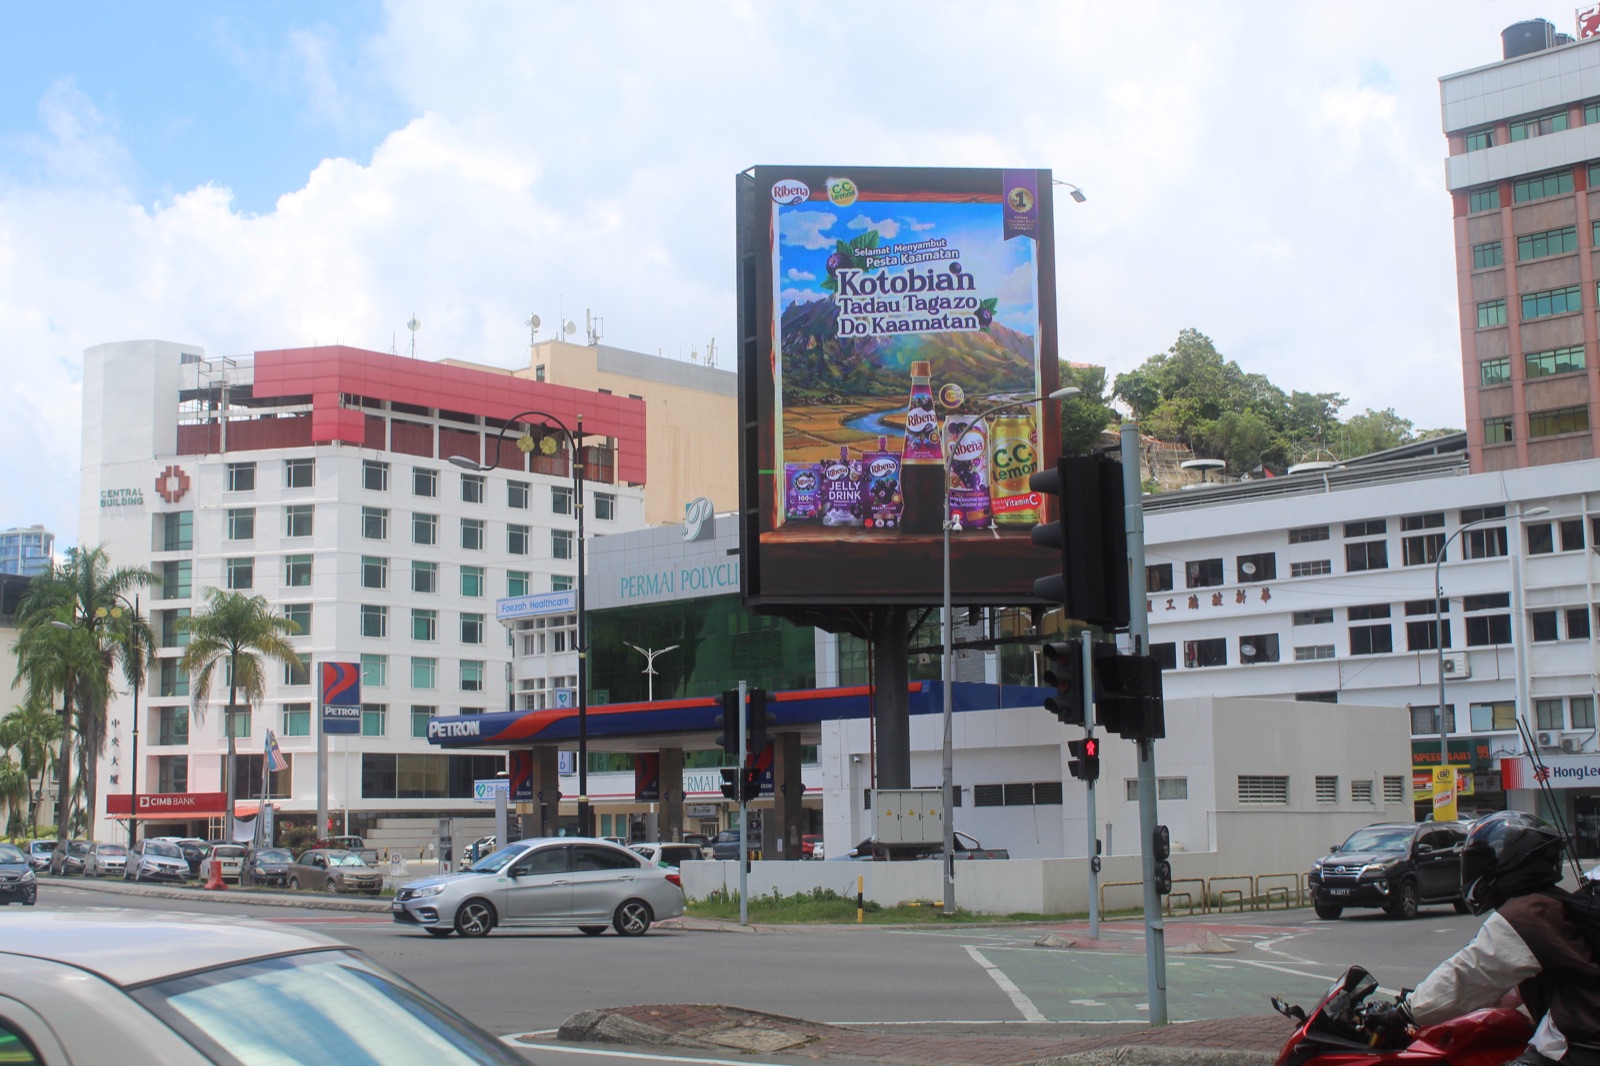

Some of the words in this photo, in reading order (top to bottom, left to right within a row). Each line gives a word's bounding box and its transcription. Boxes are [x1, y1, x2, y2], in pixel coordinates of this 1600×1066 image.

[774, 185, 808, 198] Ribena
[854, 247, 890, 257] Selamat
[894, 237, 947, 253] Menyambut
[866, 255, 898, 268] Pesta
[901, 249, 959, 265] Kaamatan
[839, 268, 976, 296] Kotobian
[839, 296, 901, 315] Tadau
[903, 293, 978, 316] Tagazo
[840, 318, 867, 336] Do
[872, 313, 977, 334] Kaamatan
[907, 413, 937, 427] Ribena
[993, 443, 1033, 468] C.C.
[827, 467, 849, 477] Ribena
[871, 461, 896, 473] Ribena
[992, 461, 1038, 482] Lemon
[100, 488, 143, 498] CENTRAL
[829, 481, 861, 491] JELLY
[829, 490, 861, 500] DRINK
[1005, 496, 1030, 507] Vitamin
[1029, 493, 1039, 506] C
[100, 497, 144, 508] BUILDING
[620, 571, 674, 599] PERMAI
[501, 601, 527, 613] Faezah
[530, 597, 569, 609] Healthcare
[325, 706, 359, 717] PETRON
[428, 720, 480, 738] PETRON
[1476, 745, 1490, 760] 99
[766, 771, 770, 779] 8
[487, 785, 494, 793] Dr
[150, 797, 172, 806] CIMB
[173, 796, 195, 805] BANK
